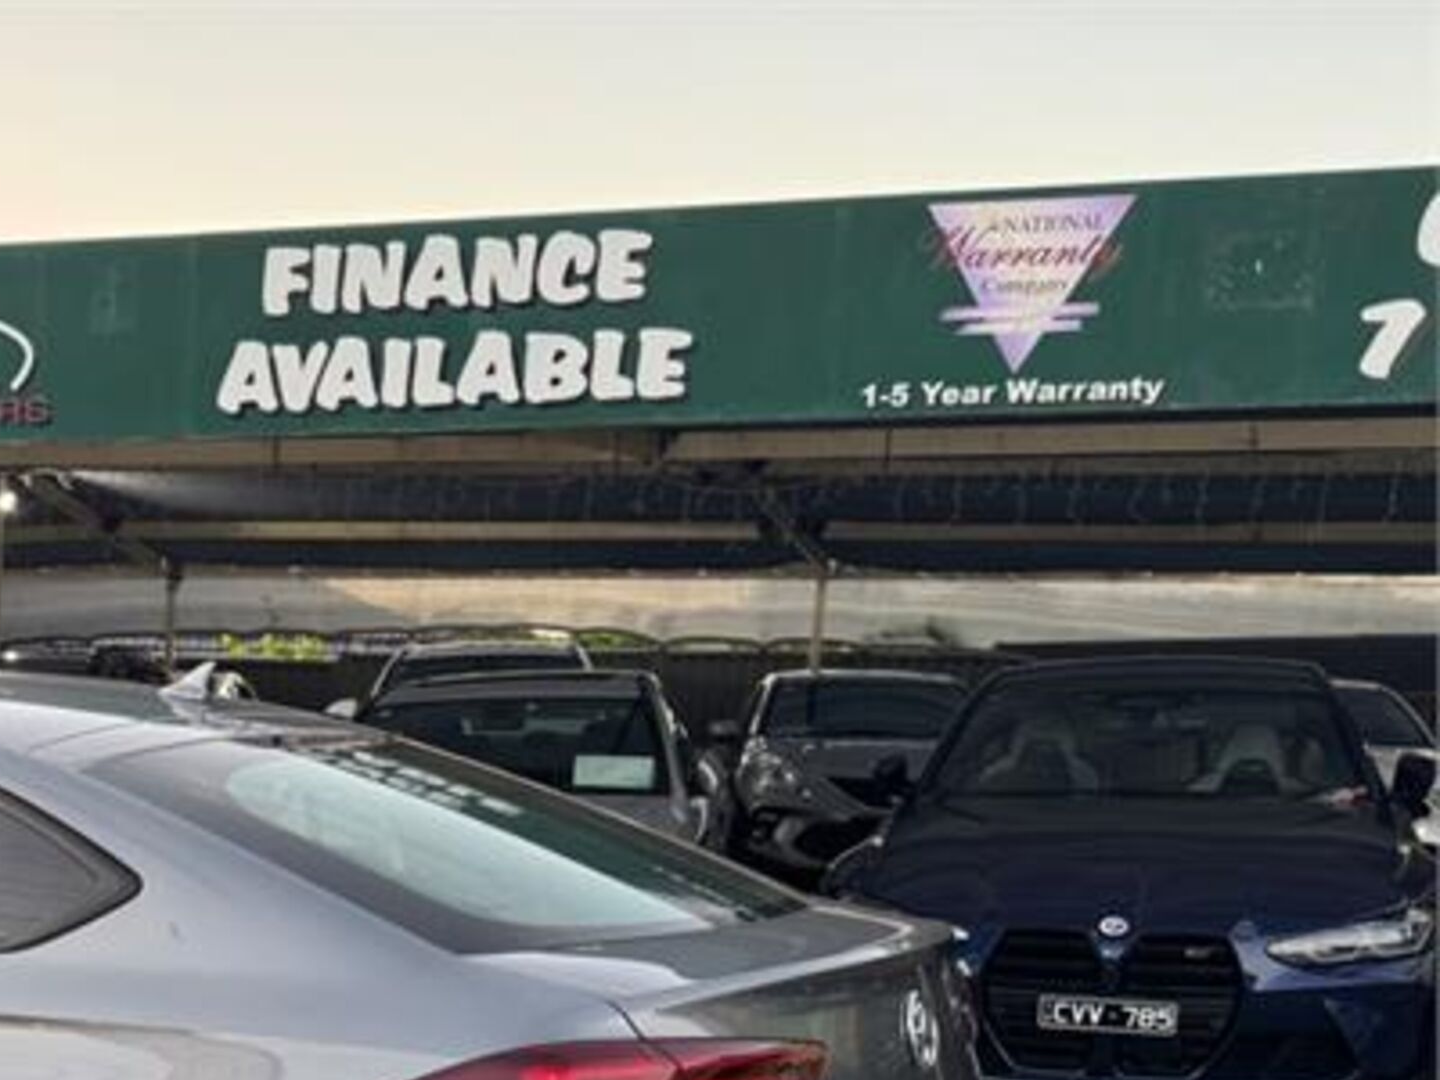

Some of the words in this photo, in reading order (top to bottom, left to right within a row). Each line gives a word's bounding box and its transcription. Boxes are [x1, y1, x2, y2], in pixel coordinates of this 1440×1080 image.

[263, 229, 652, 317] FINANCE
[216, 328, 693, 413] AVAILABLE
[862, 383, 909, 408] 1-5
[921, 380, 998, 405] Year
[1006, 376, 1164, 407] Warranty
